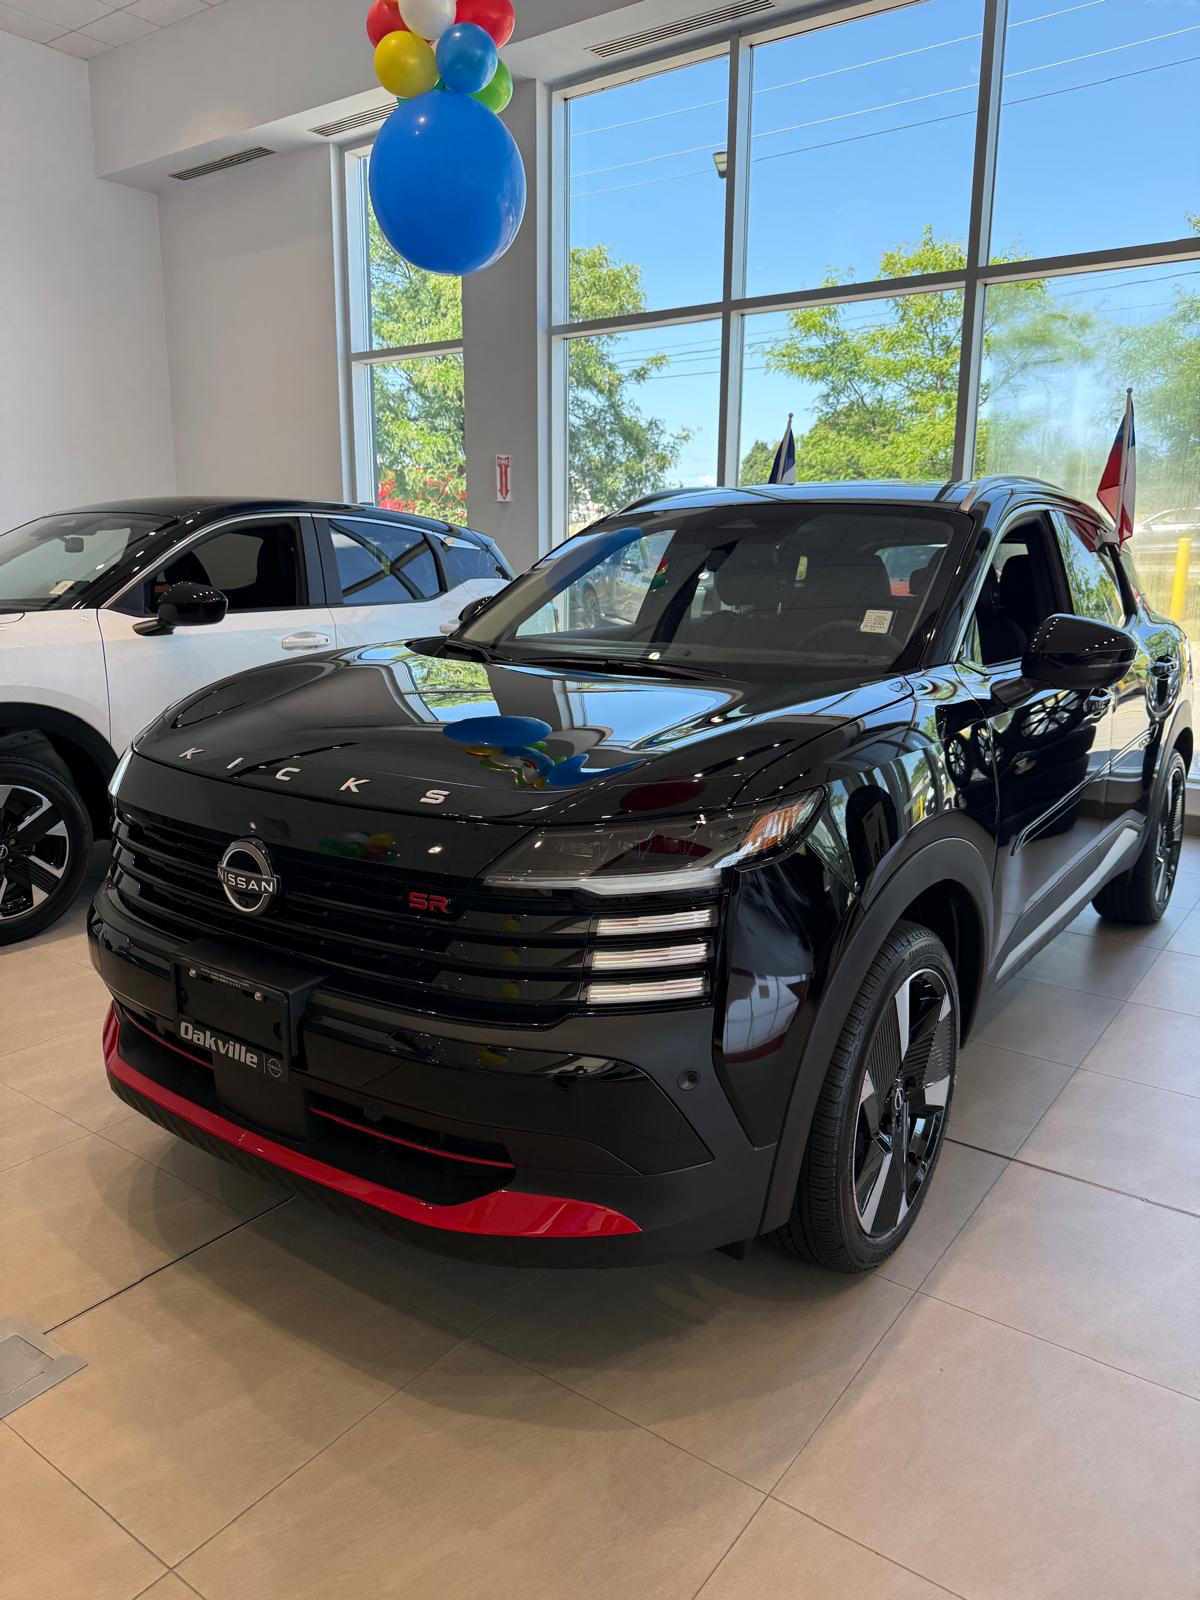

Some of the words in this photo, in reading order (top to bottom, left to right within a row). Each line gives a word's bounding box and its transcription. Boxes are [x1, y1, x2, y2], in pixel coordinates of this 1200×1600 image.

[178, 747, 451, 805] KICKS
[217, 866, 274, 893] NISSAN
[408, 891, 449, 913] SR
[180, 1021, 259, 1069] Oakville
